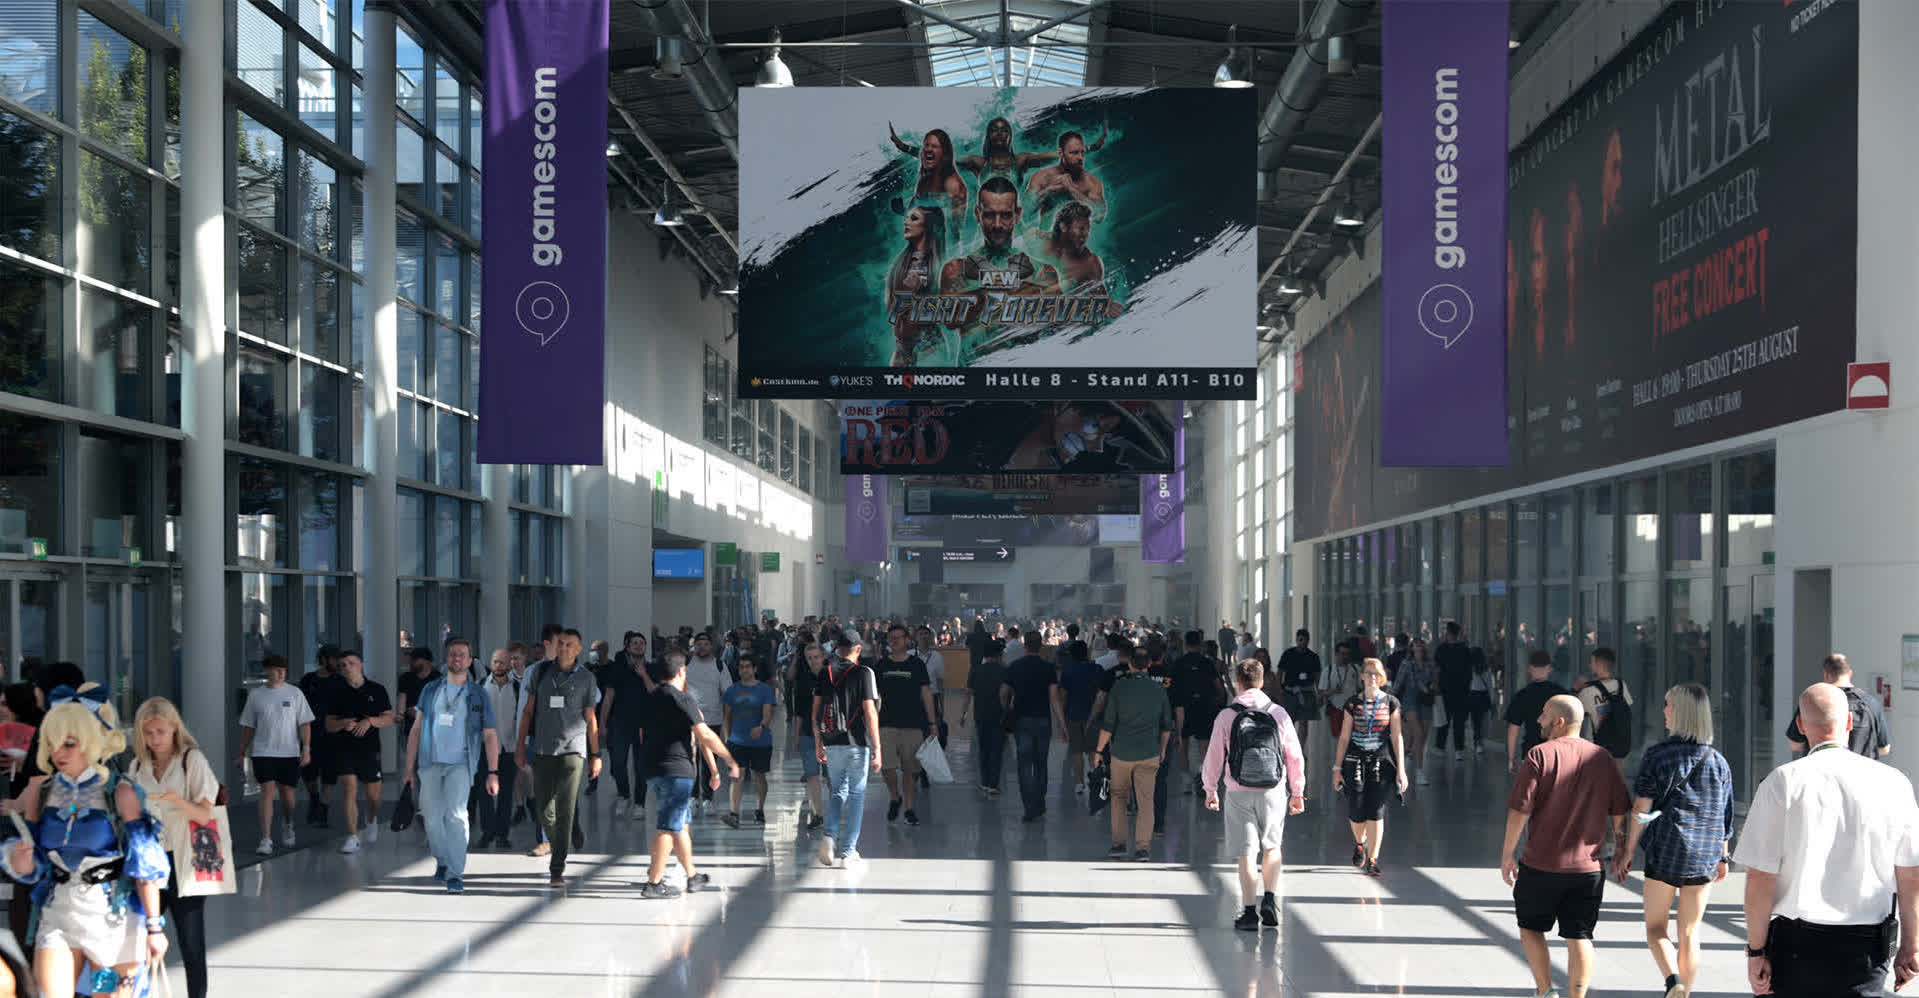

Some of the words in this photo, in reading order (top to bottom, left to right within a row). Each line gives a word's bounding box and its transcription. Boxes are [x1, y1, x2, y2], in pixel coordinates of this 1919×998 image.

[1606, 16, 1685, 105] GAMESCOM
[1652, 24, 1772, 208] METAL
[532, 67, 563, 267] gamescom
[1435, 68, 1466, 269] gamescom
[1659, 167, 1760, 264] HELLSINGER
[888, 292, 977, 325] FIGHT
[981, 292, 1110, 325] FOREVER
[980, 271, 1019, 287] AEW
[1652, 268, 1691, 348] FREE
[1693, 226, 1770, 319] CONCERT
[840, 375, 873, 386] YUKE'S
[985, 373, 1041, 387] Halle
[1050, 373, 1062, 387] 8
[1087, 373, 1148, 387] Stand
[1208, 373, 1245, 387] B10
[1686, 350, 1732, 389] THURSDAY
[1732, 341, 1757, 374] 25TH
[1758, 326, 1799, 365] AUGUST
[843, 418, 950, 466] RED
[844, 405, 873, 417] ONE
[876, 405, 910, 417] PIECE
